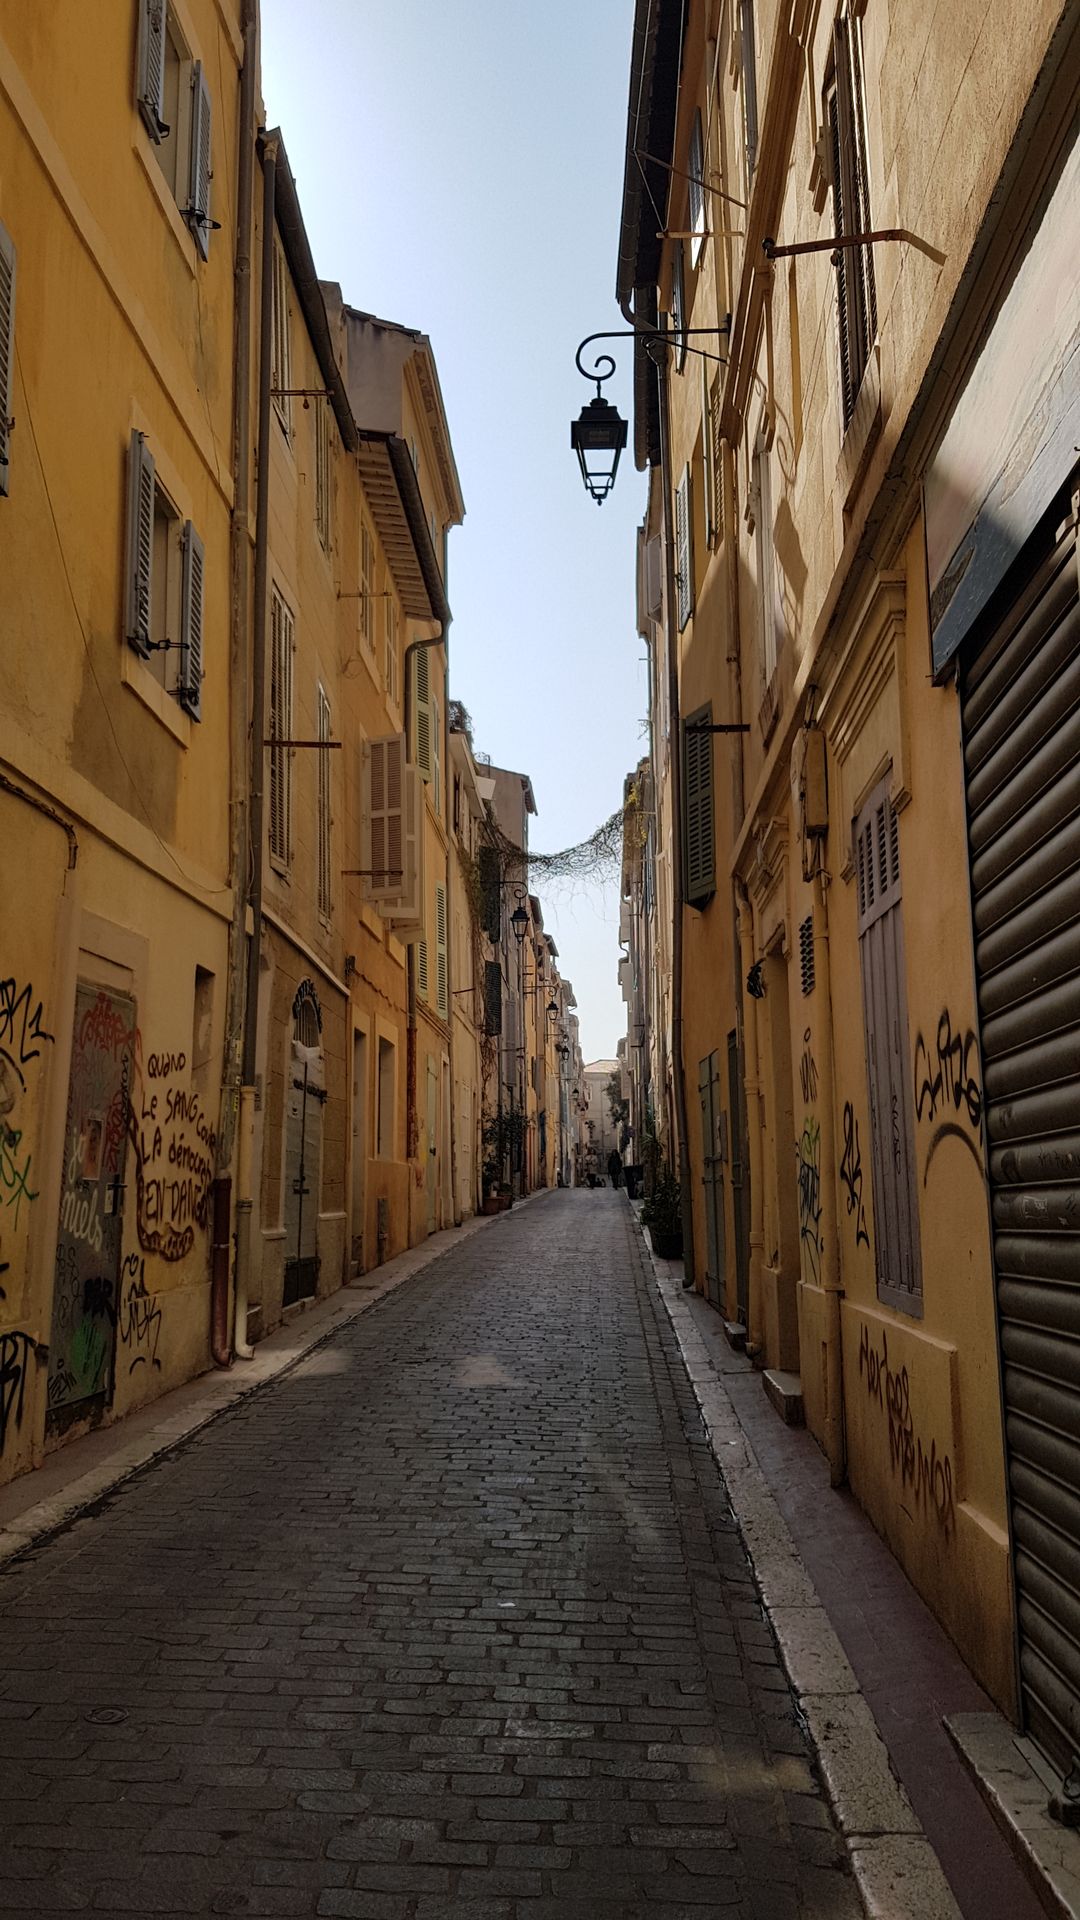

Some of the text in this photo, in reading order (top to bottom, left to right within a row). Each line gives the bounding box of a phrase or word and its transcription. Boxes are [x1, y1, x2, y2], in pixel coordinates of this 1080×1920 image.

[165, 1088, 198, 1125] SANG
[141, 1126, 162, 1165] LA
[145, 1177, 165, 1225] EN
